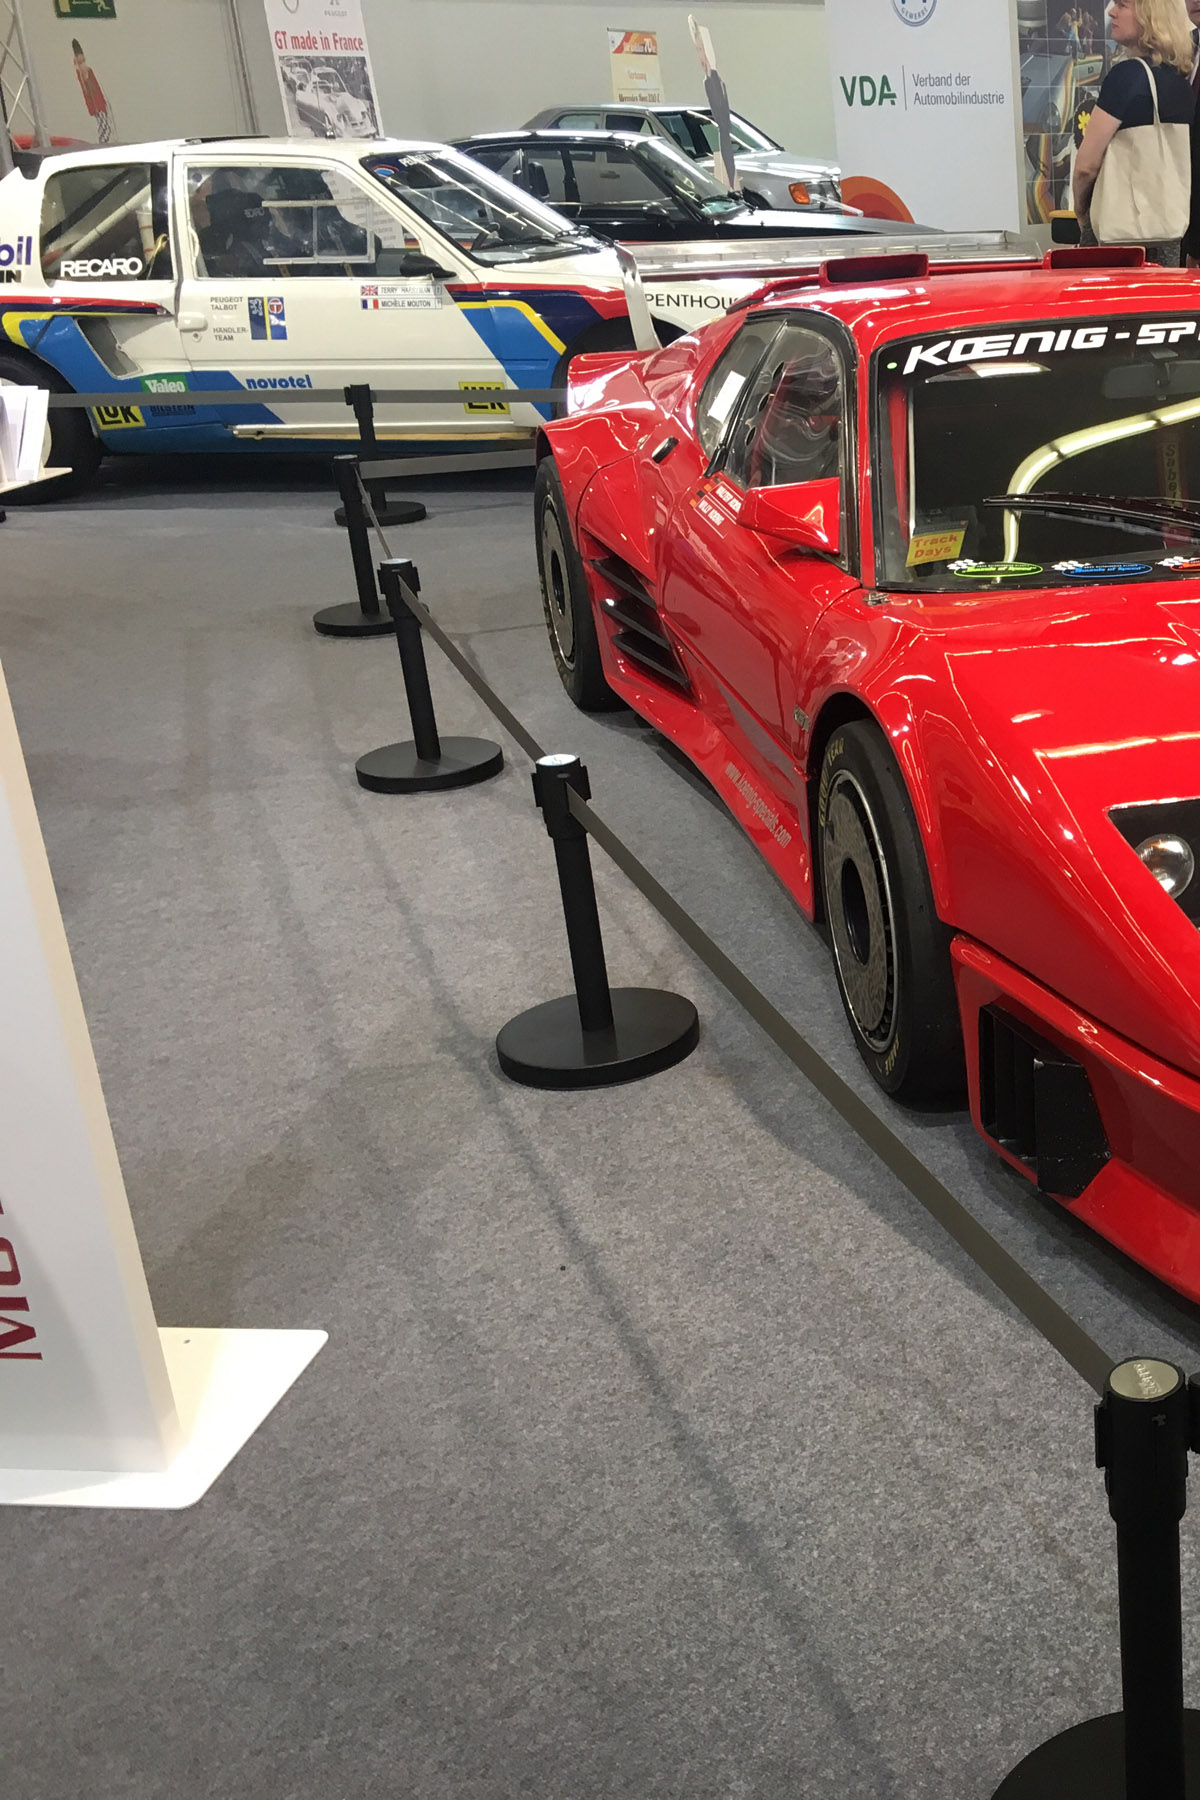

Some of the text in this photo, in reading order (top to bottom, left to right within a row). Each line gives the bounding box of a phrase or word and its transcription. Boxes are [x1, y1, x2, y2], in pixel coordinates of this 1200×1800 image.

[274, 31, 364, 51] GT made in France
[912, 73, 971, 87] Verband der
[840, 75, 897, 107] VDA
[914, 92, 1005, 106] Automobilindustrie
[60, 257, 143, 278] RECARO
[146, 378, 186, 393] Valeo
[246, 374, 313, 389] novotel
[914, 534, 958, 547] Track
[914, 547, 951, 559] Days
[725, 761, 792, 849] www.koenig-specials.com
